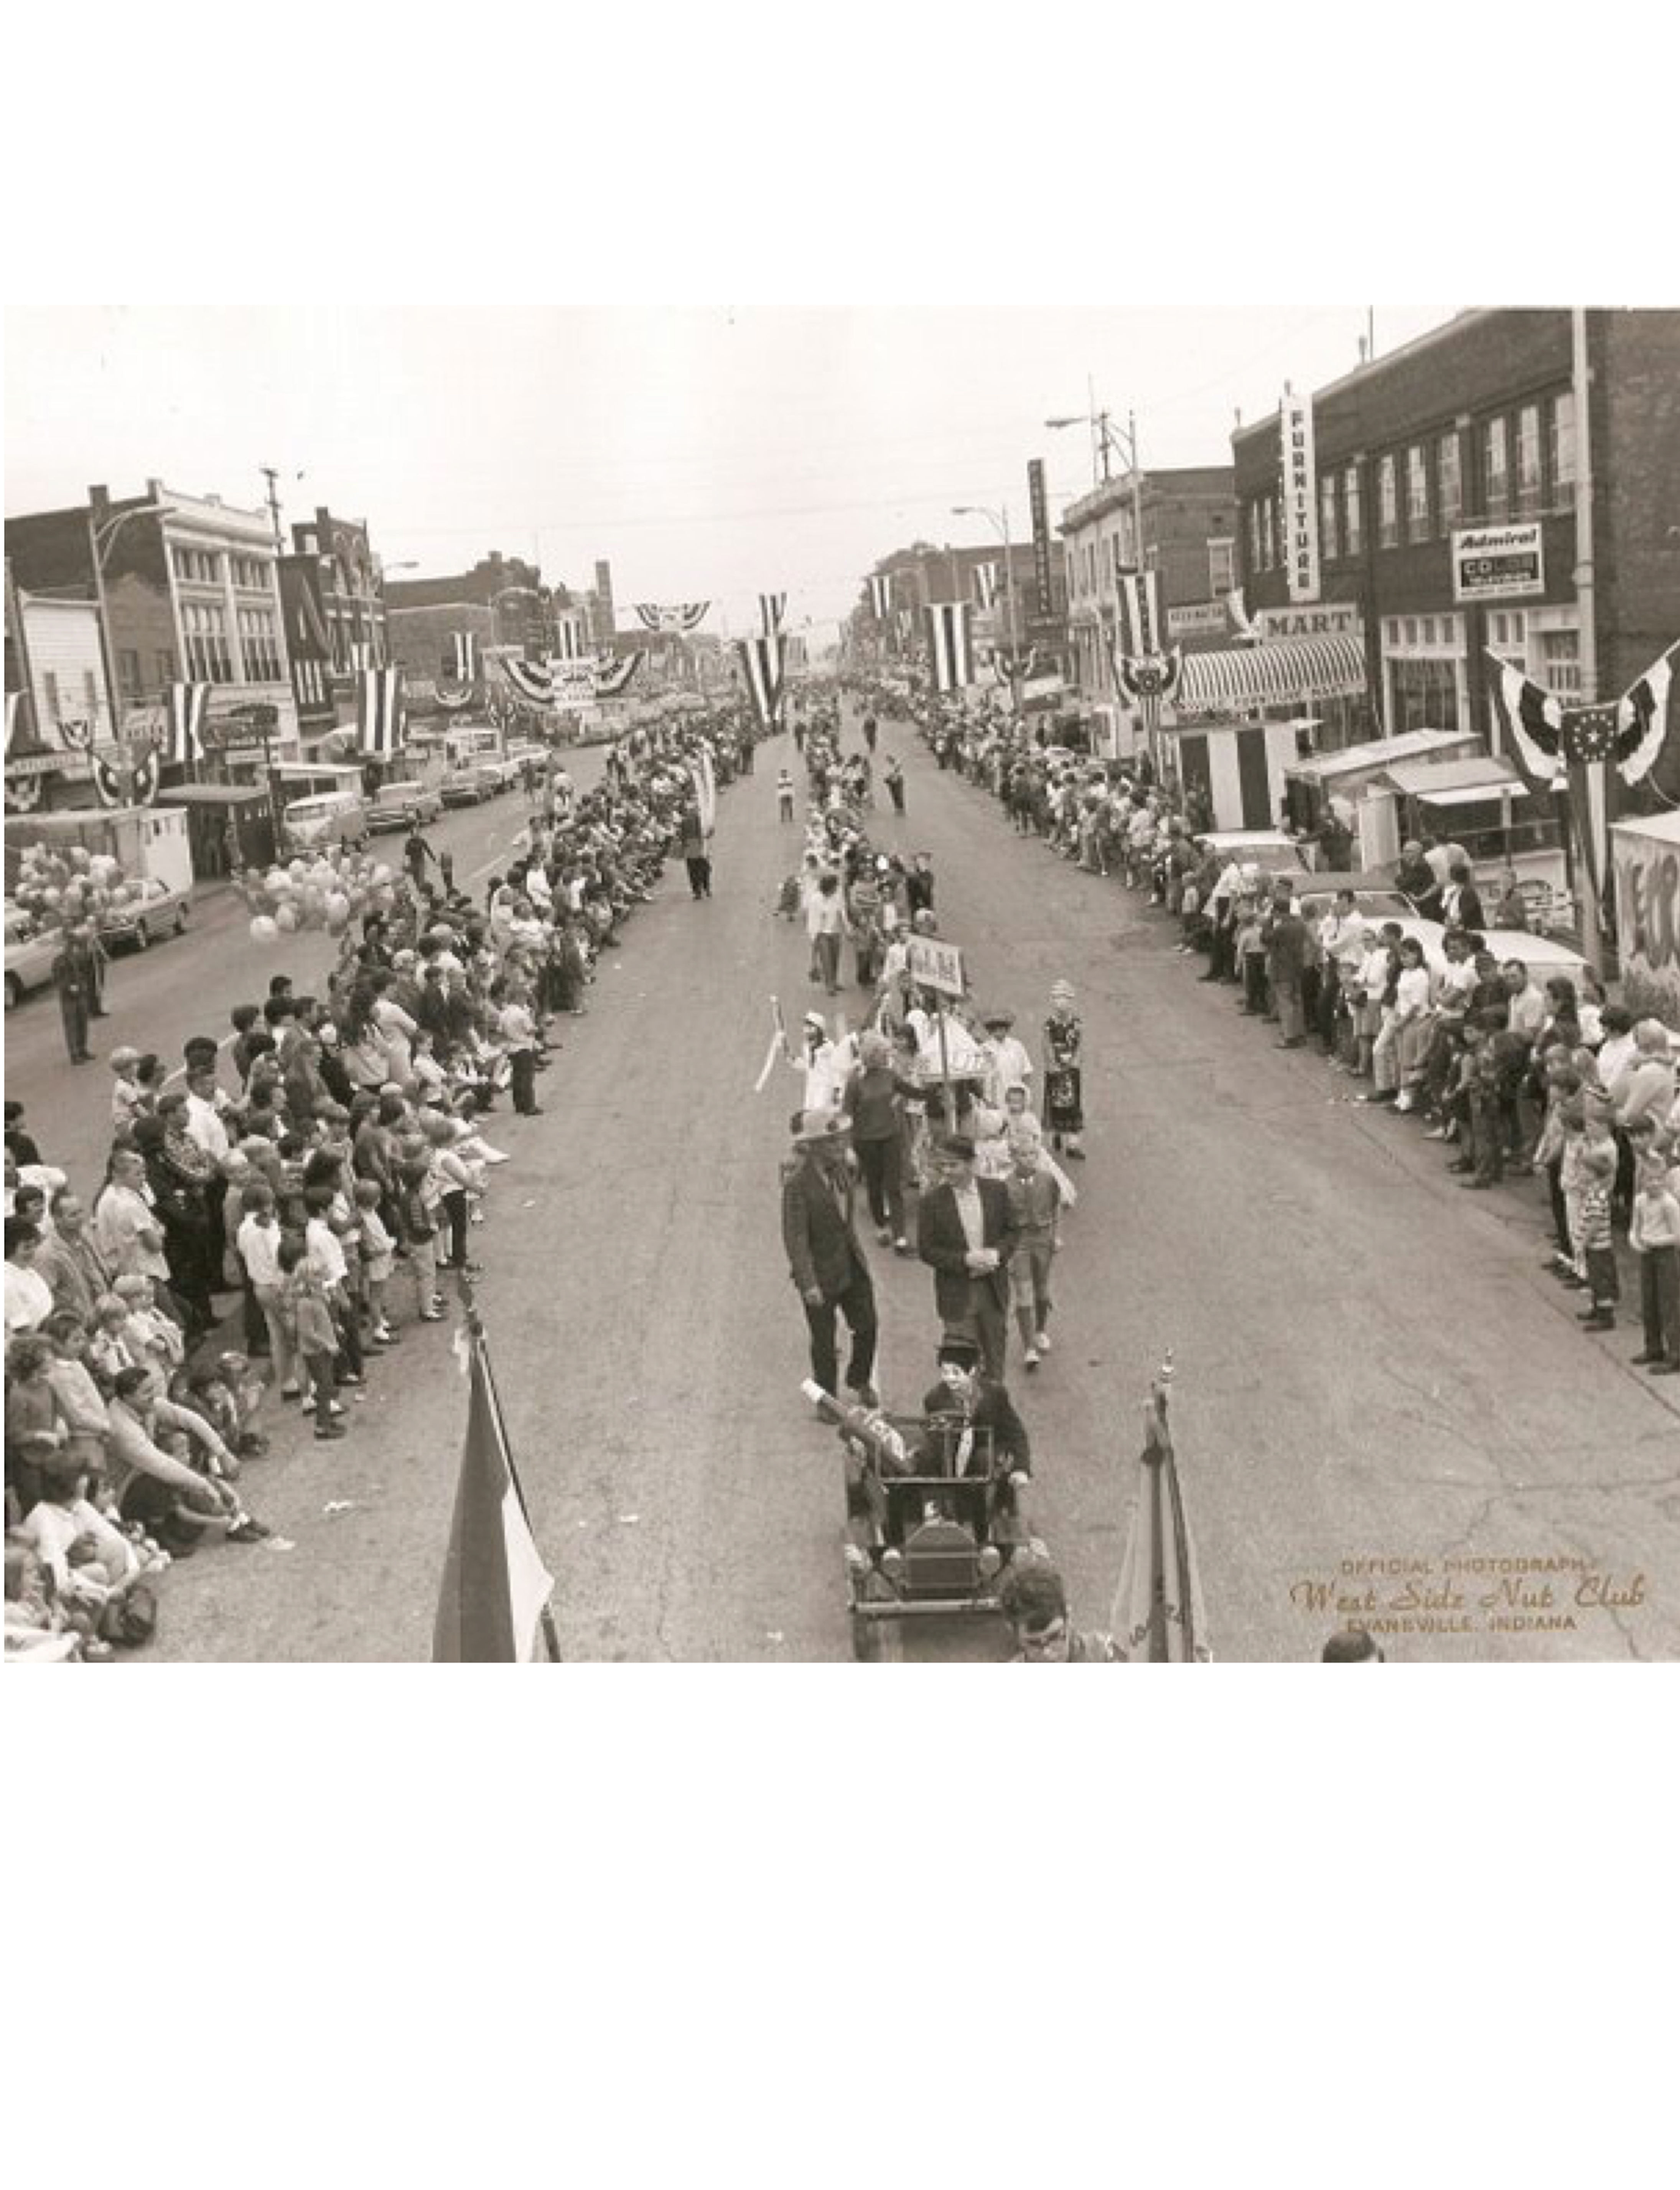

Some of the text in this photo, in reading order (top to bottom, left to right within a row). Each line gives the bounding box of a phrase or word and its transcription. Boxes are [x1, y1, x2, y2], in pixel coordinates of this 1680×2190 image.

[1290, 409, 1310, 588] FURNITURE
[1461, 528, 1536, 549] Admiral
[1267, 612, 1351, 637] MART
